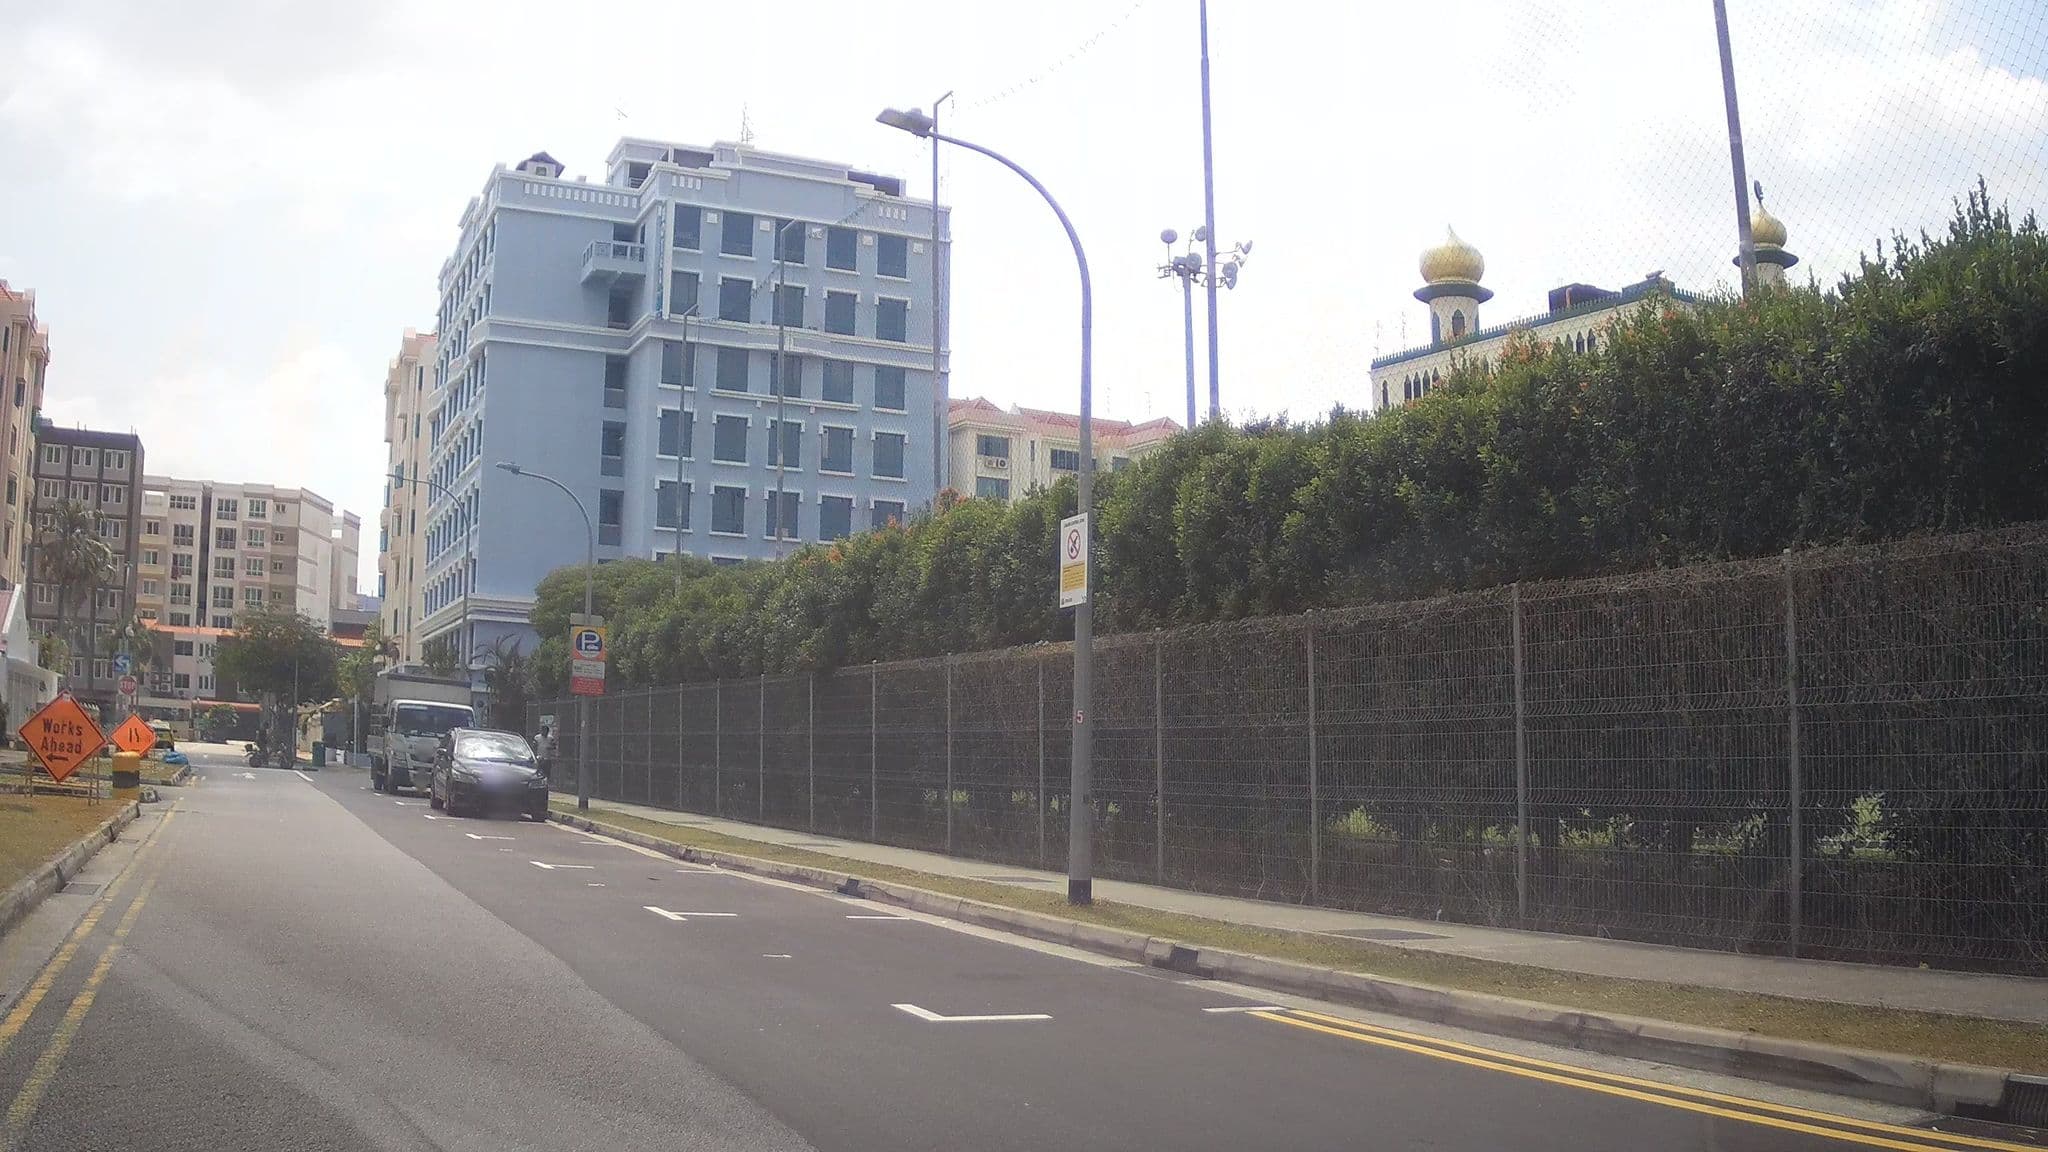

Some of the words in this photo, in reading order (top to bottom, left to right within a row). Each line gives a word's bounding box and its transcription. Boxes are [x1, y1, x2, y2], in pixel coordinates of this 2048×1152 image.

[581, 631, 600, 651] P
[1076, 710, 1083, 724] 5
[43, 719, 83, 737] Works
[41, 737, 82, 754] Ahead
